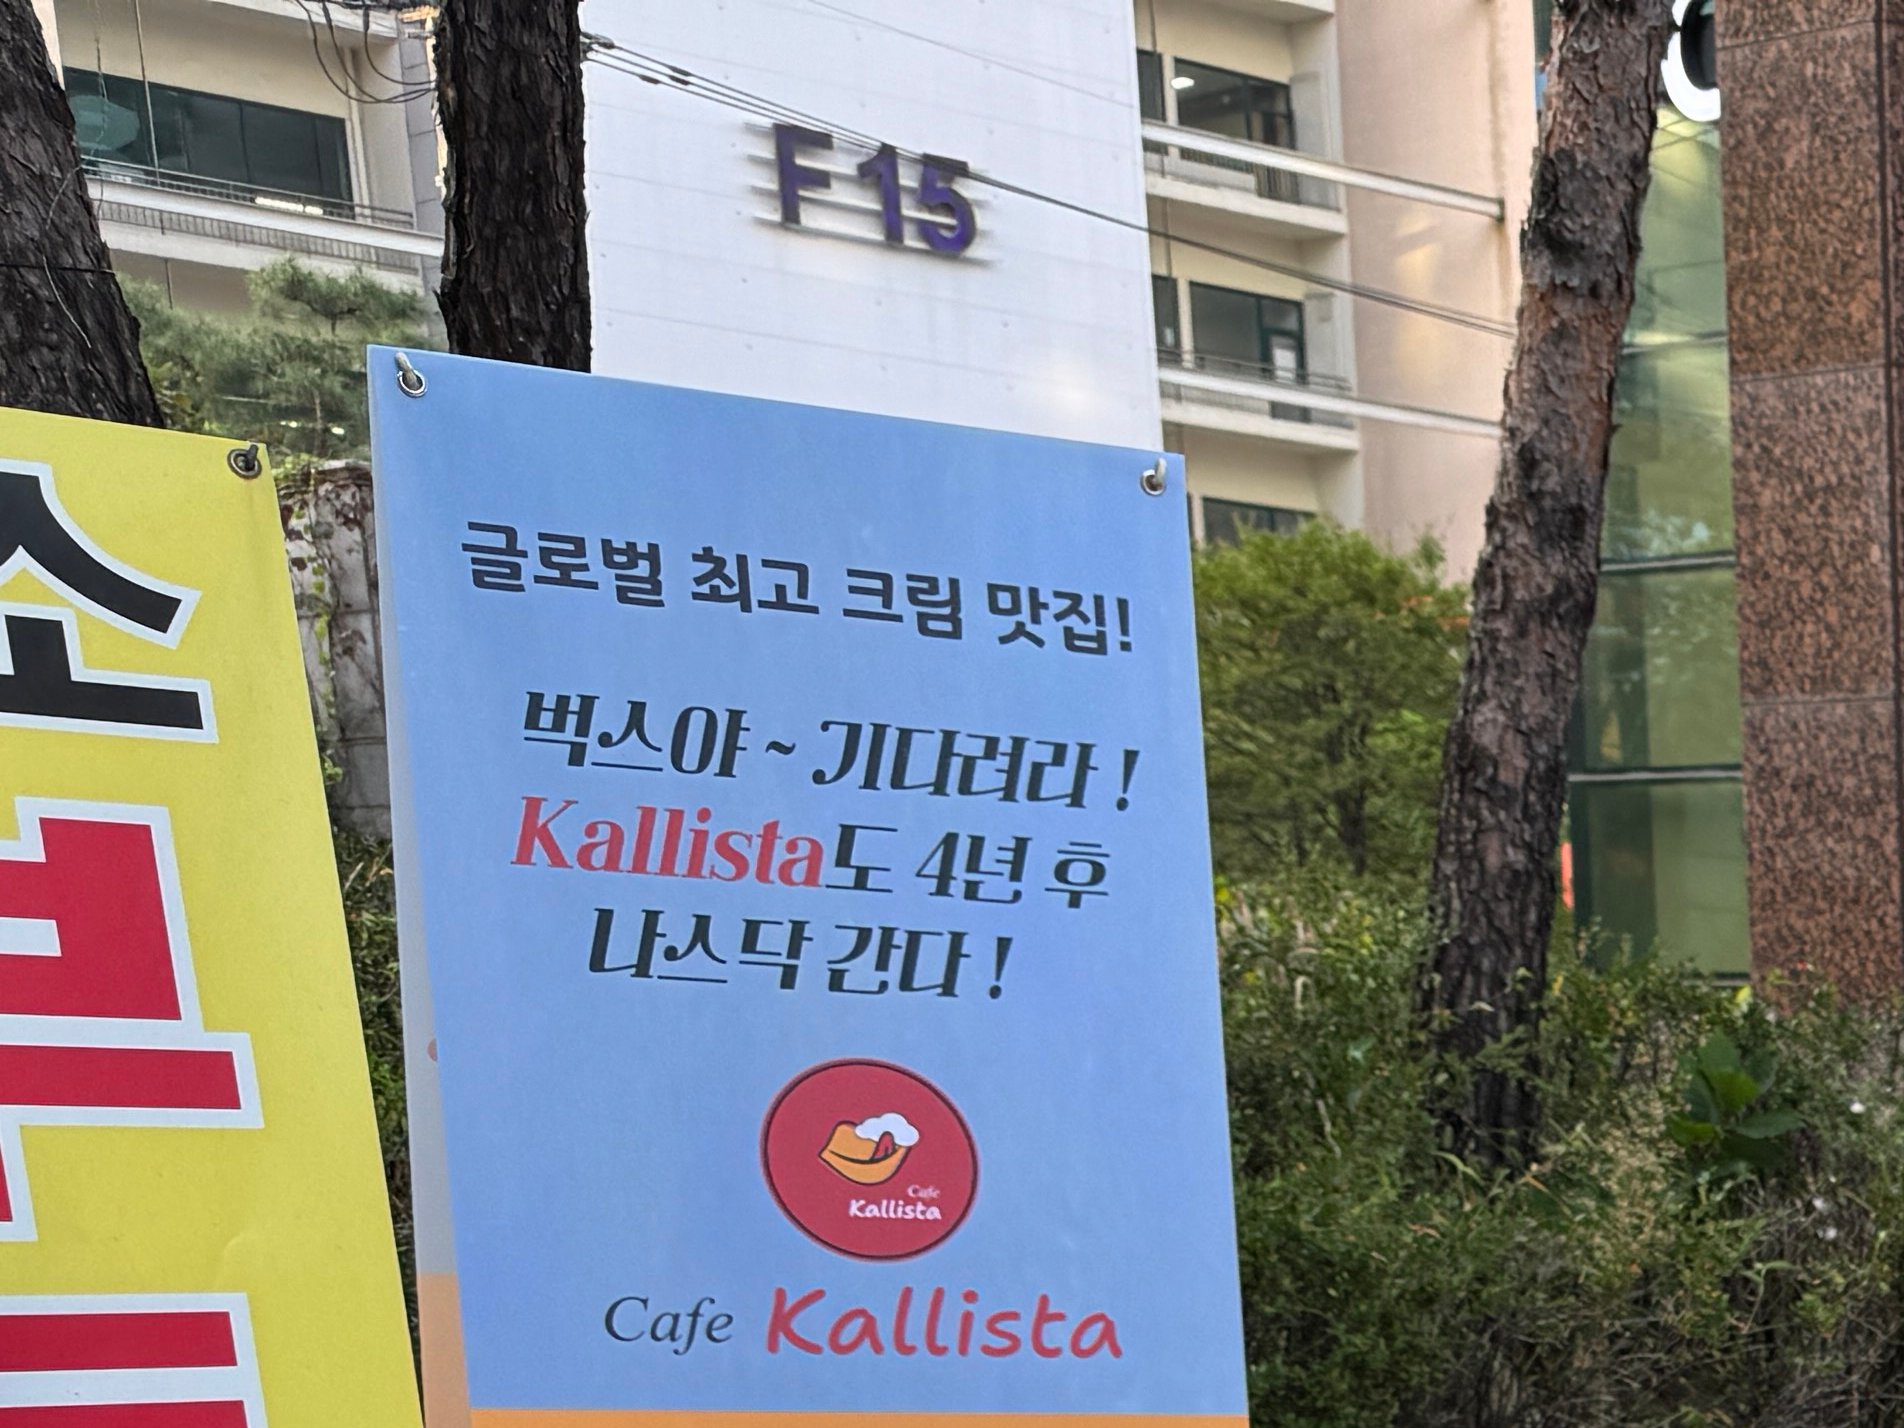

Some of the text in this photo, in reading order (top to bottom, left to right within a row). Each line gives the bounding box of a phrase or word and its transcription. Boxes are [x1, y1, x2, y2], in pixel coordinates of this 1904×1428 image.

[462, 522, 1134, 656] 글로벌 최고 크림 맛집!
[524, 691, 751, 778] 벅스야
[511, 796, 1112, 909] Kallista도 4년 후
[588, 907, 815, 991] 나스닥
[849, 1199, 942, 1220] Kallista
[604, 1286, 1124, 1359] Cafe Kallista
